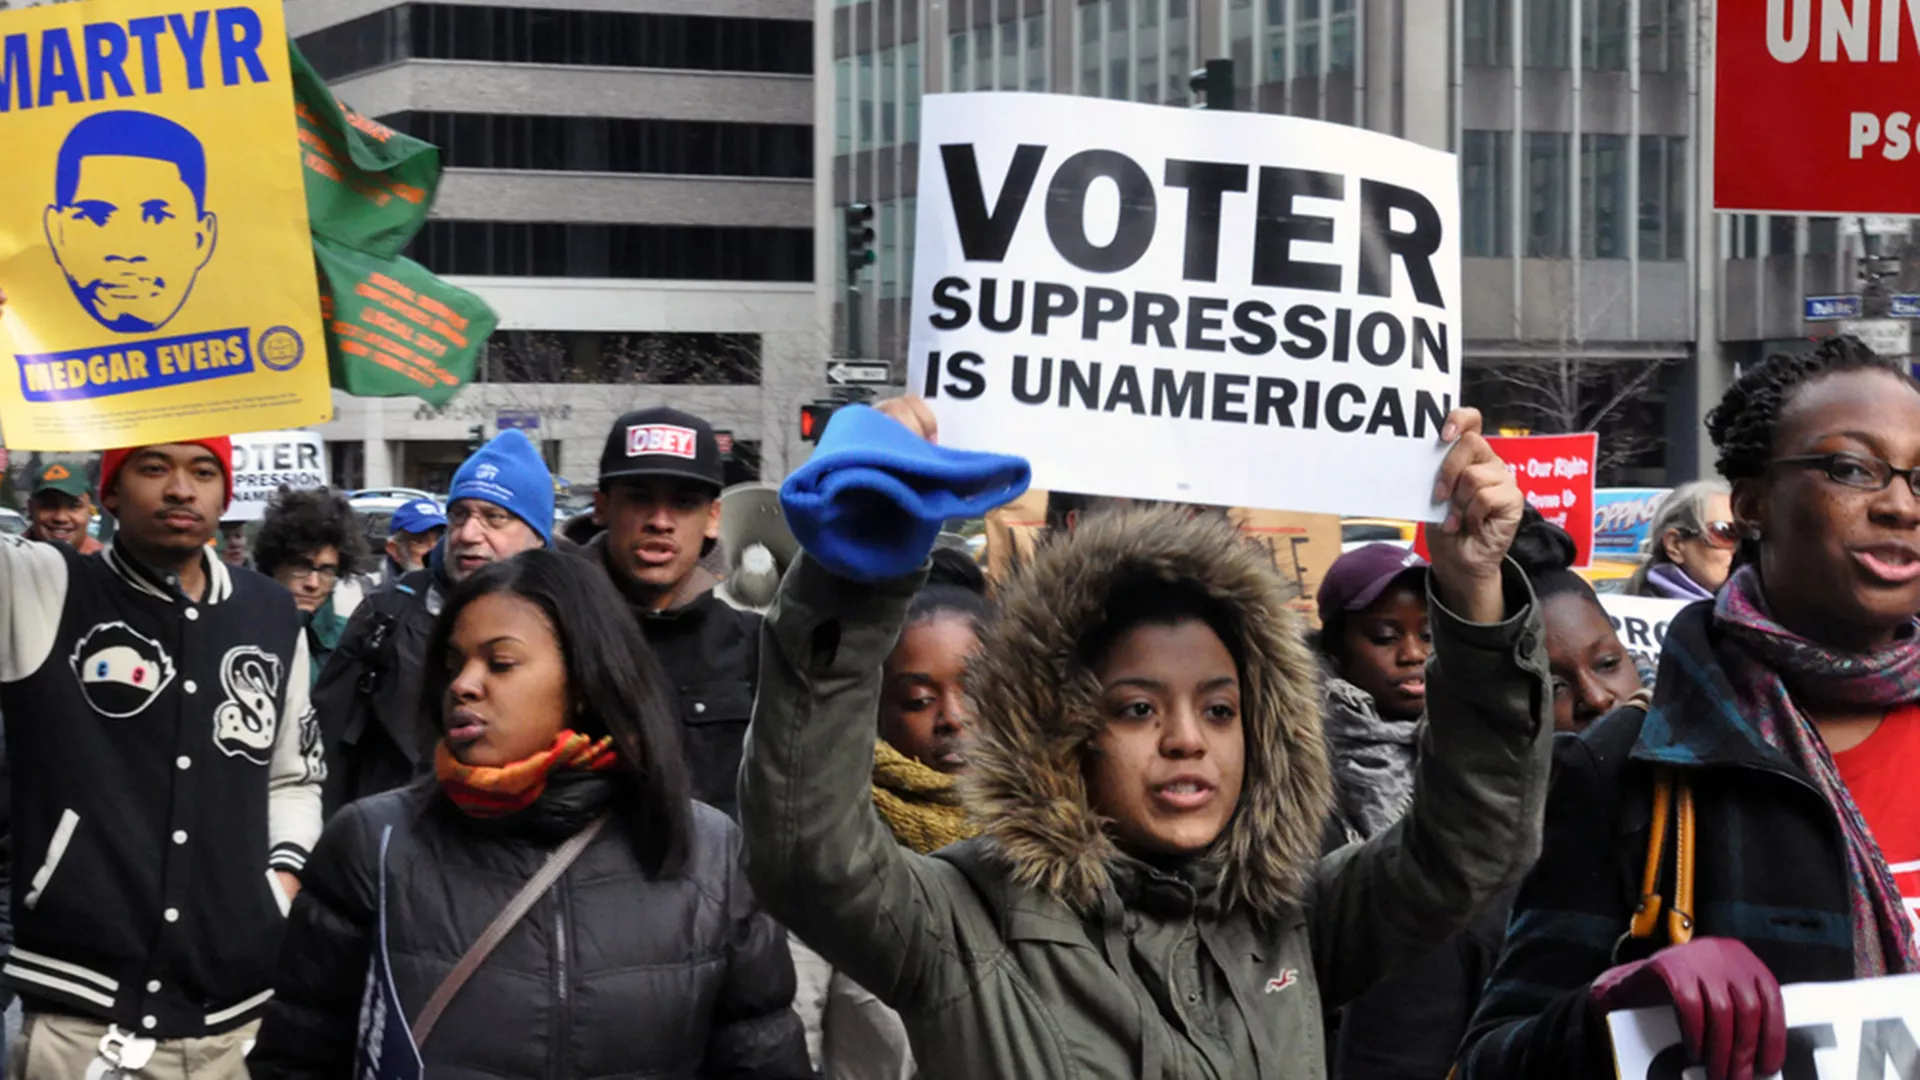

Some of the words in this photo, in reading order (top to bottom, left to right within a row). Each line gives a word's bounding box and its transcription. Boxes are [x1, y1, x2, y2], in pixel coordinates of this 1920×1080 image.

[0, 6, 270, 113] MARTYR
[1766, 0, 1920, 63] UNI
[1849, 111, 1920, 161] PS
[939, 142, 1446, 310] VOTER
[928, 276, 1450, 375] SUPPRESSION
[24, 350, 150, 393] MEDGAR
[156, 335, 246, 376] EVERS
[923, 350, 987, 400] IS
[1011, 354, 1451, 440] UNAMERICAN
[632, 429, 692, 454] OBEY
